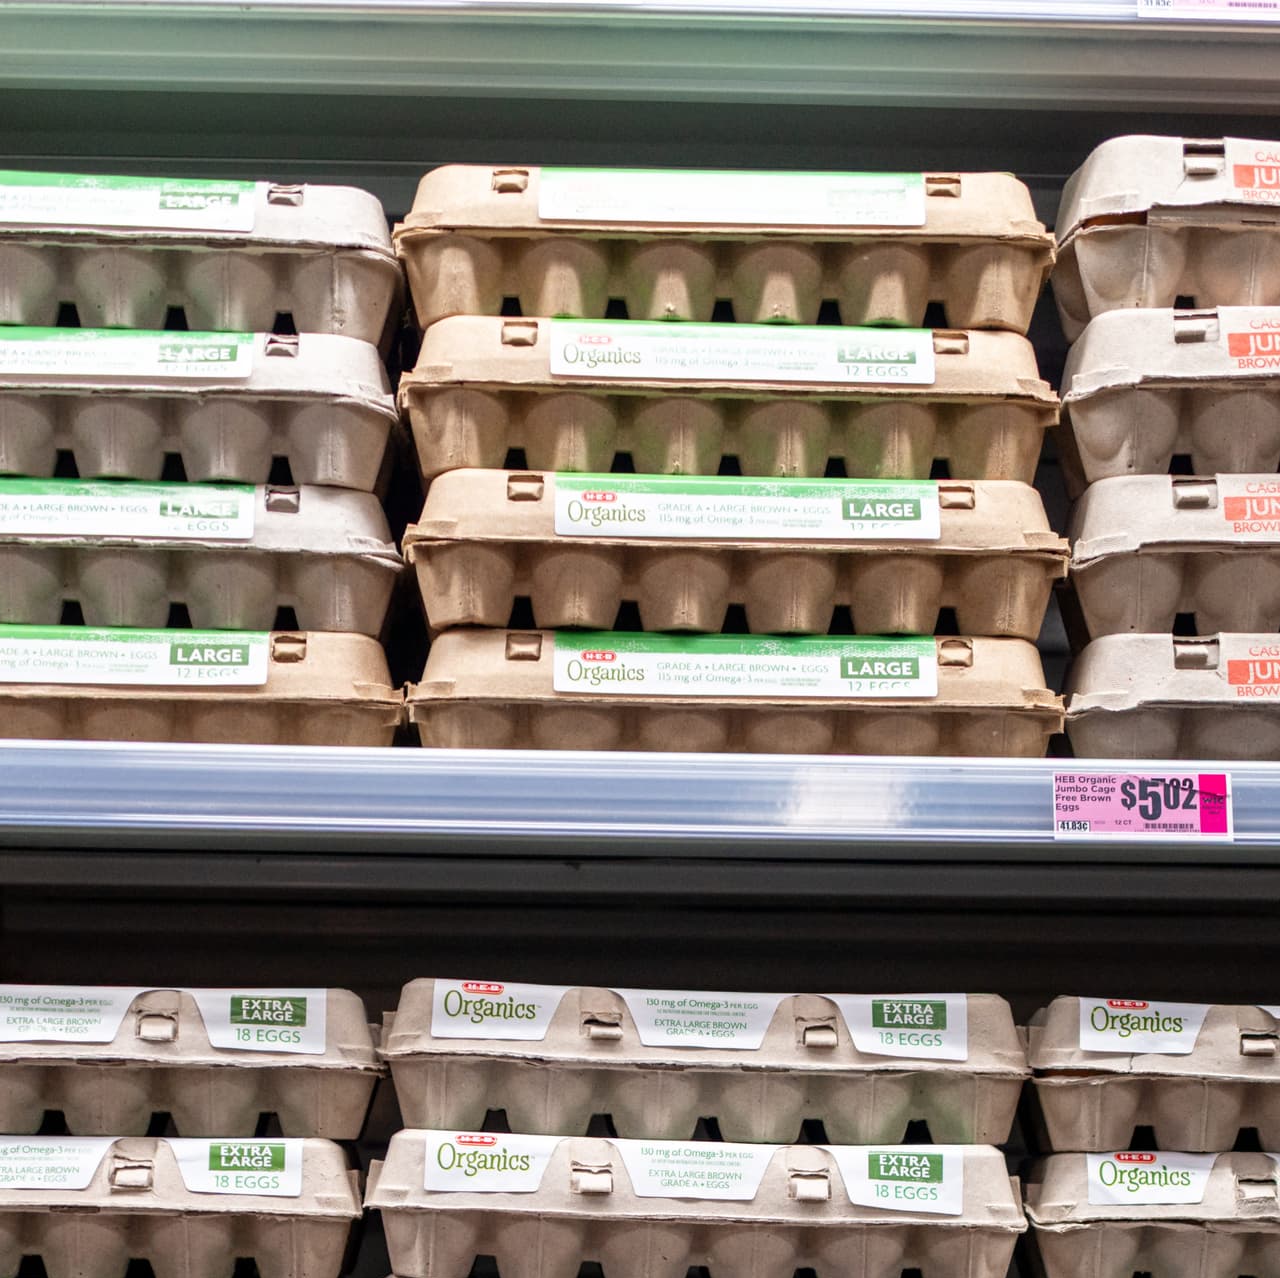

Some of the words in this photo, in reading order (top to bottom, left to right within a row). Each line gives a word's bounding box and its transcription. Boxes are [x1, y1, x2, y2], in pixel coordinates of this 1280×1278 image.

[563, 343, 641, 368] Organics
[567, 500, 646, 527] Organics
[849, 502, 915, 518] LARGE
[176, 647, 242, 663] LARGE
[567, 660, 645, 686] Organics
[847, 661, 913, 676] LARGE
[1055, 776, 1075, 784] HEB
[1078, 776, 1117, 786] Organic
[1055, 785, 1088, 793] Jumbo
[1091, 786, 1116, 795] Cage
[1056, 794, 1077, 802] Free
[1080, 794, 1111, 802] Brown
[1056, 803, 1080, 812] Eggs
[241, 999, 294, 1012] EXTRA
[444, 990, 537, 1025] Organics
[882, 1003, 934, 1015] EXTRA
[242, 1009, 294, 1022] LARGE
[883, 1014, 934, 1026] LARGE
[1091, 1006, 1184, 1038] Organics
[235, 1028, 253, 1043] 18
[256, 1029, 301, 1044] EGGS
[879, 1032, 894, 1046] 18
[898, 1033, 942, 1047] EGGS
[437, 1142, 531, 1178] Organics
[1099, 1161, 1191, 1193] Organics
